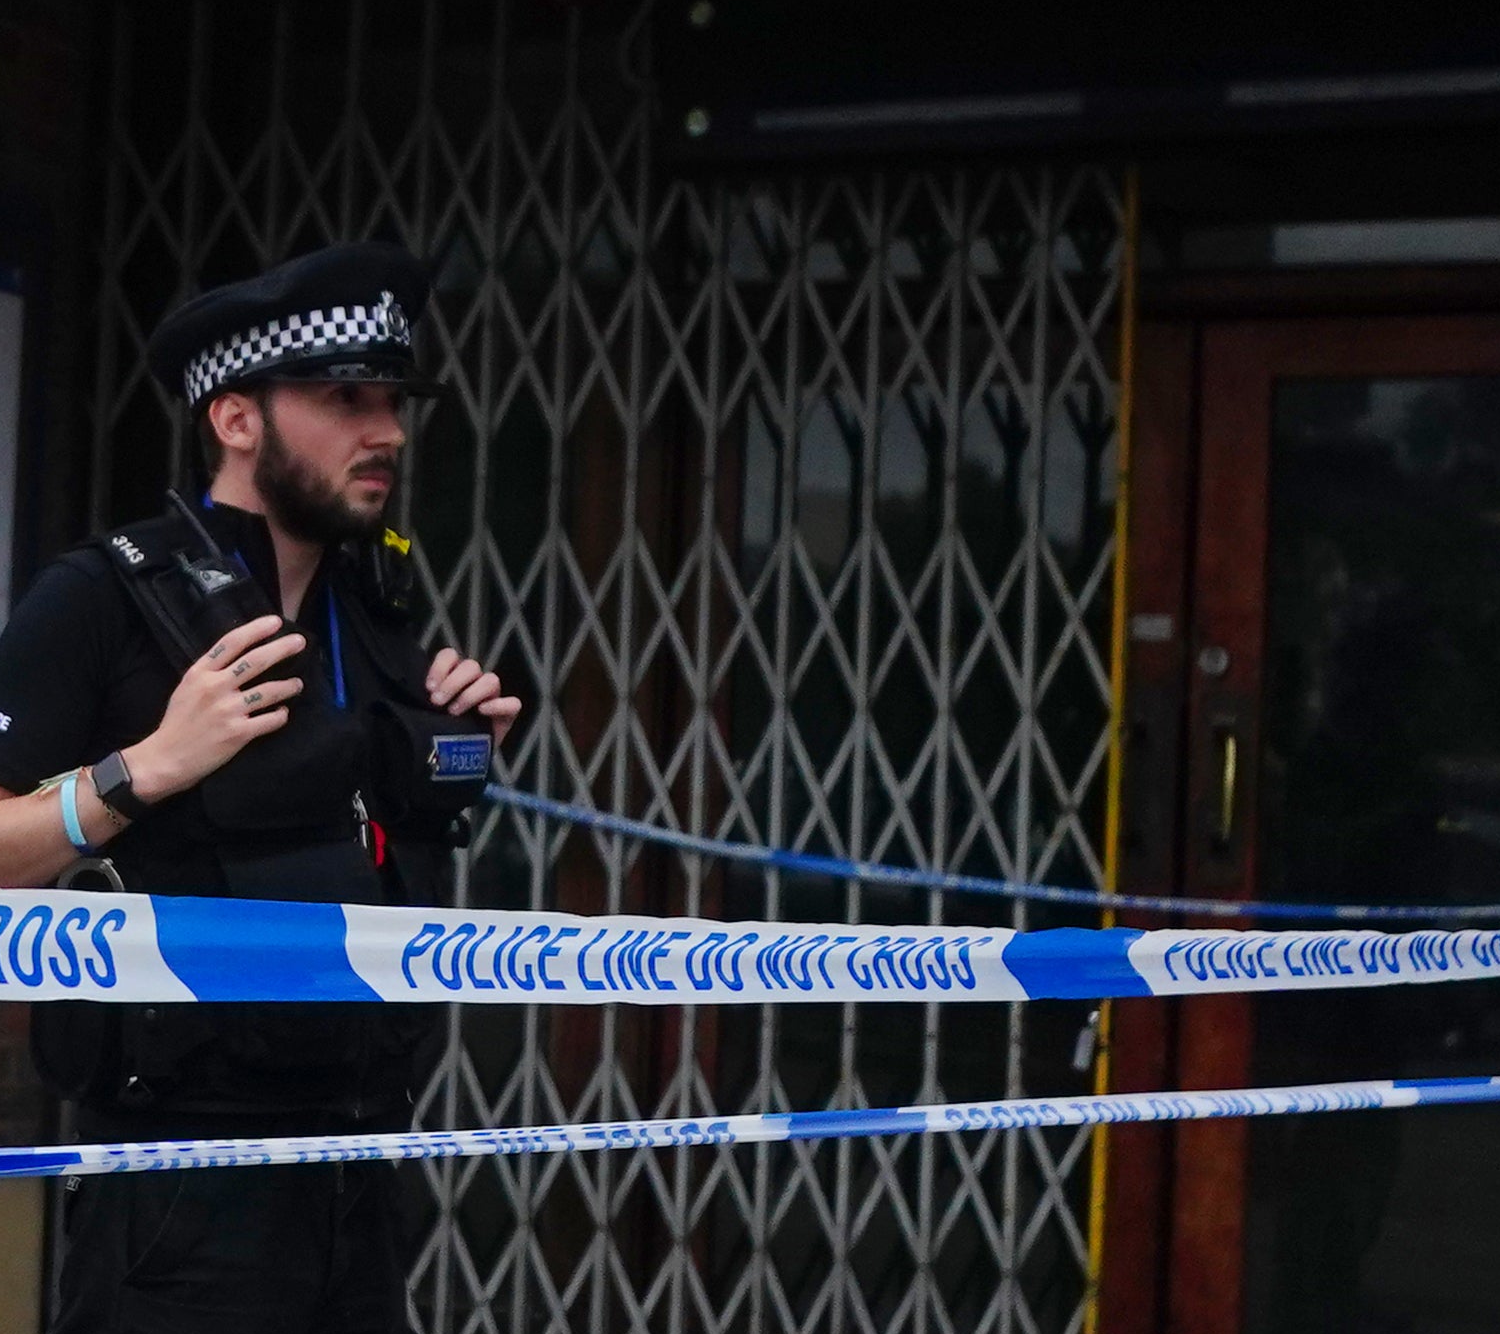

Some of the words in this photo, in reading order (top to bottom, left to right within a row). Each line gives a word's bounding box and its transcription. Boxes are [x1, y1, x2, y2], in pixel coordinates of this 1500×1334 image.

[111, 535, 145, 565] 3143
[401, 923, 580, 991] POLICE
[577, 928, 692, 992] LINE
[685, 931, 761, 992] DO
[756, 933, 858, 991] NOT
[851, 935, 993, 991] CROSS
[1163, 938, 1280, 983] POLICE
[1283, 938, 1355, 978] LINE
[1358, 936, 1401, 975] DO
